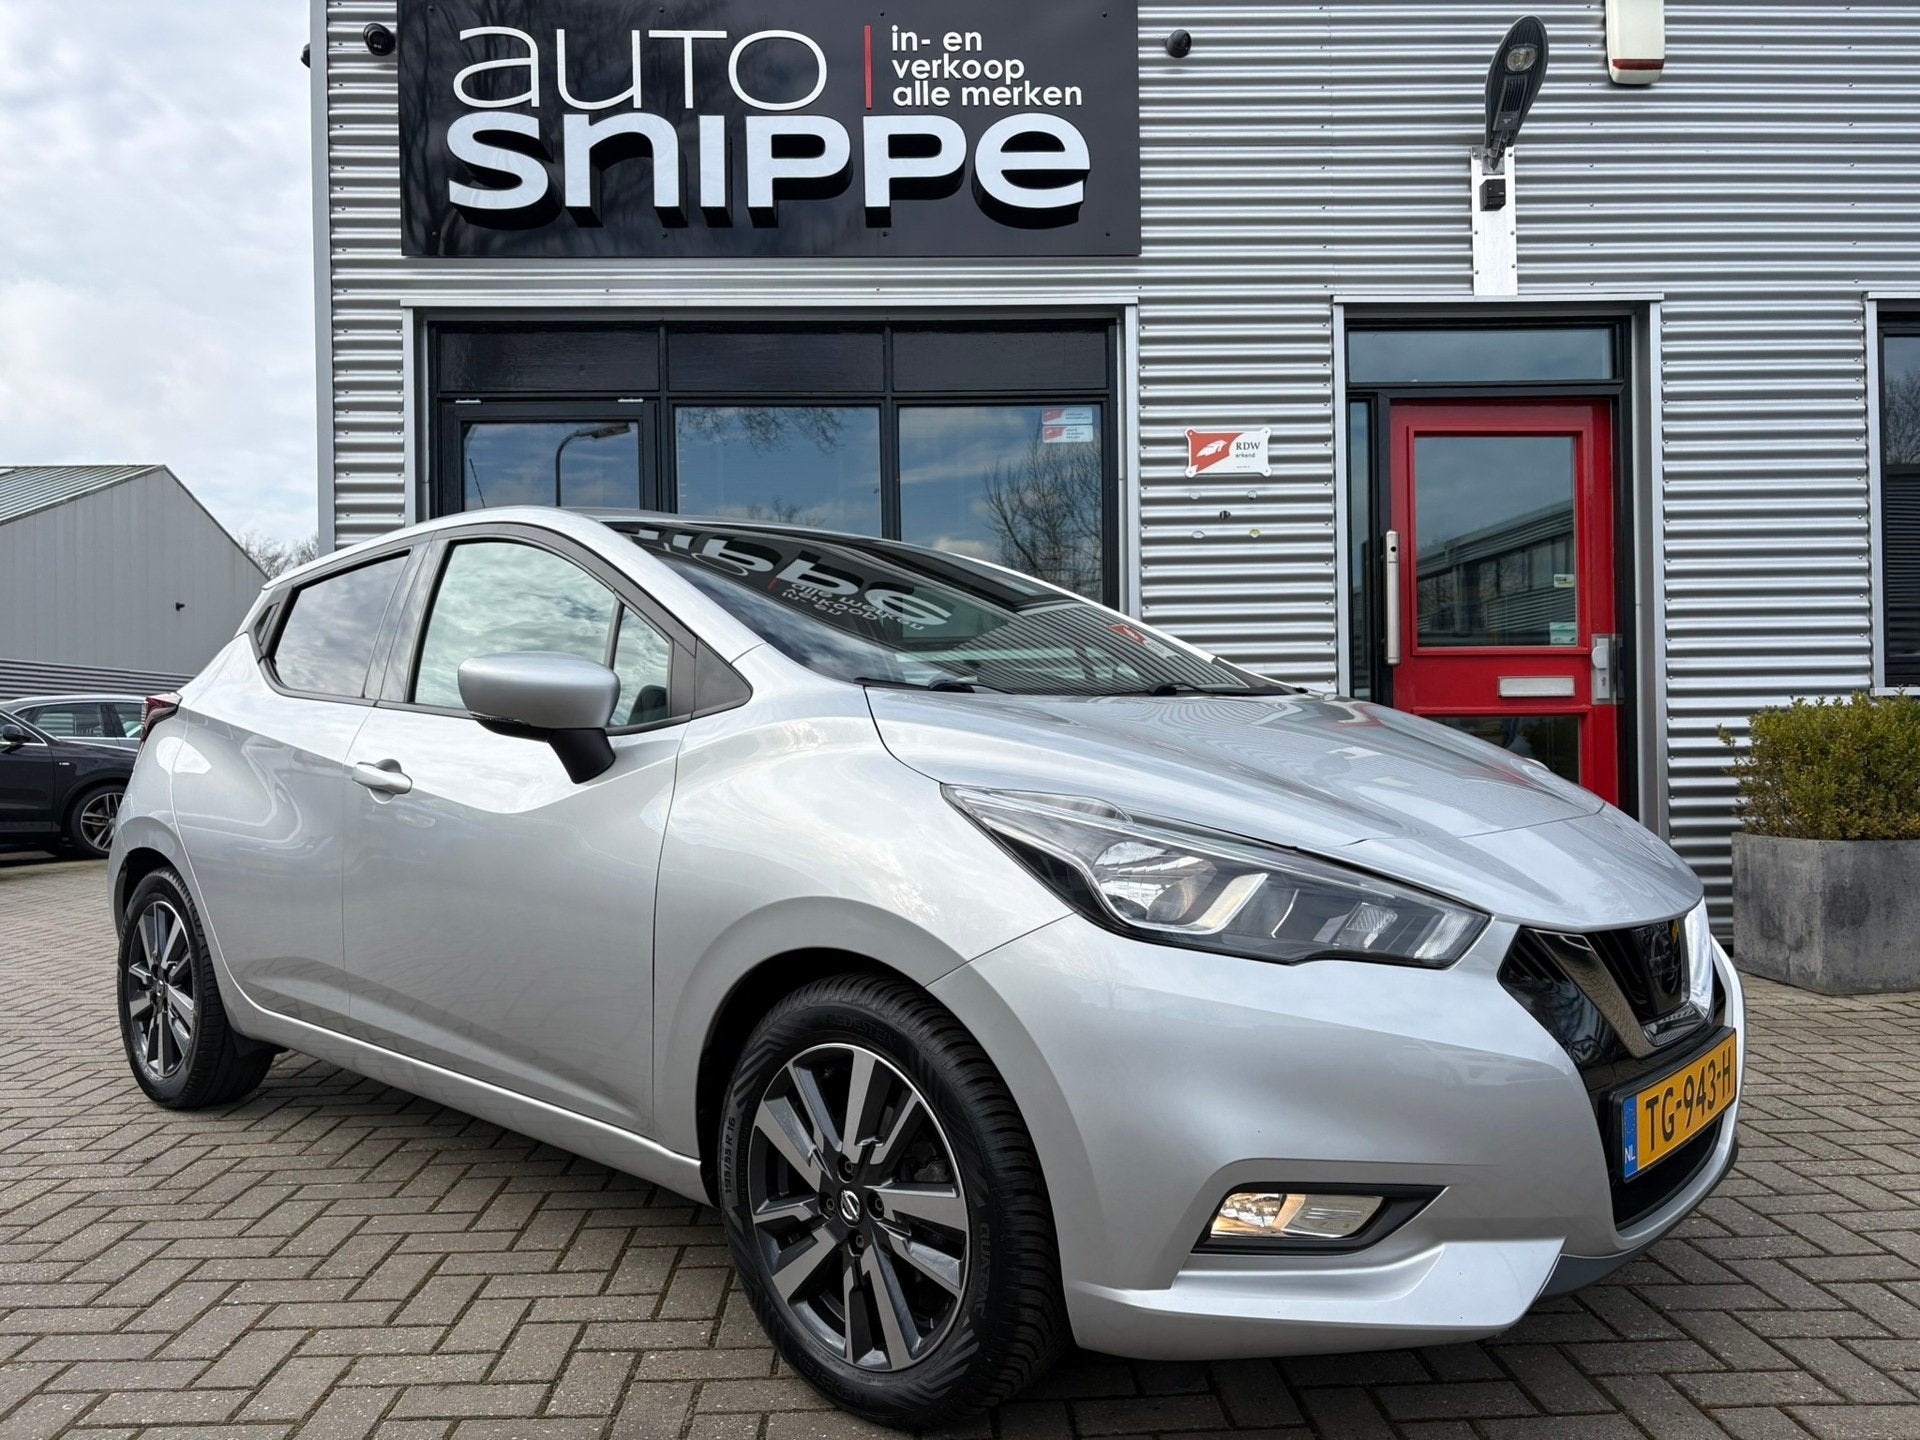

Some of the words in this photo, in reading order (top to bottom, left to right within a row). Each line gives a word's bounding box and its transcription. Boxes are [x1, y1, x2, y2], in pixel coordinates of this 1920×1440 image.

[891, 24, 931, 52] in-
[942, 31, 983, 52] en
[891, 52, 1025, 86] verkoop
[892, 79, 951, 107] alle
[961, 79, 1083, 107] merken
[1235, 441, 1261, 451] RDW
[1645, 1046, 1731, 1152] TG-943-H
[1624, 1144, 1636, 1164] NL
